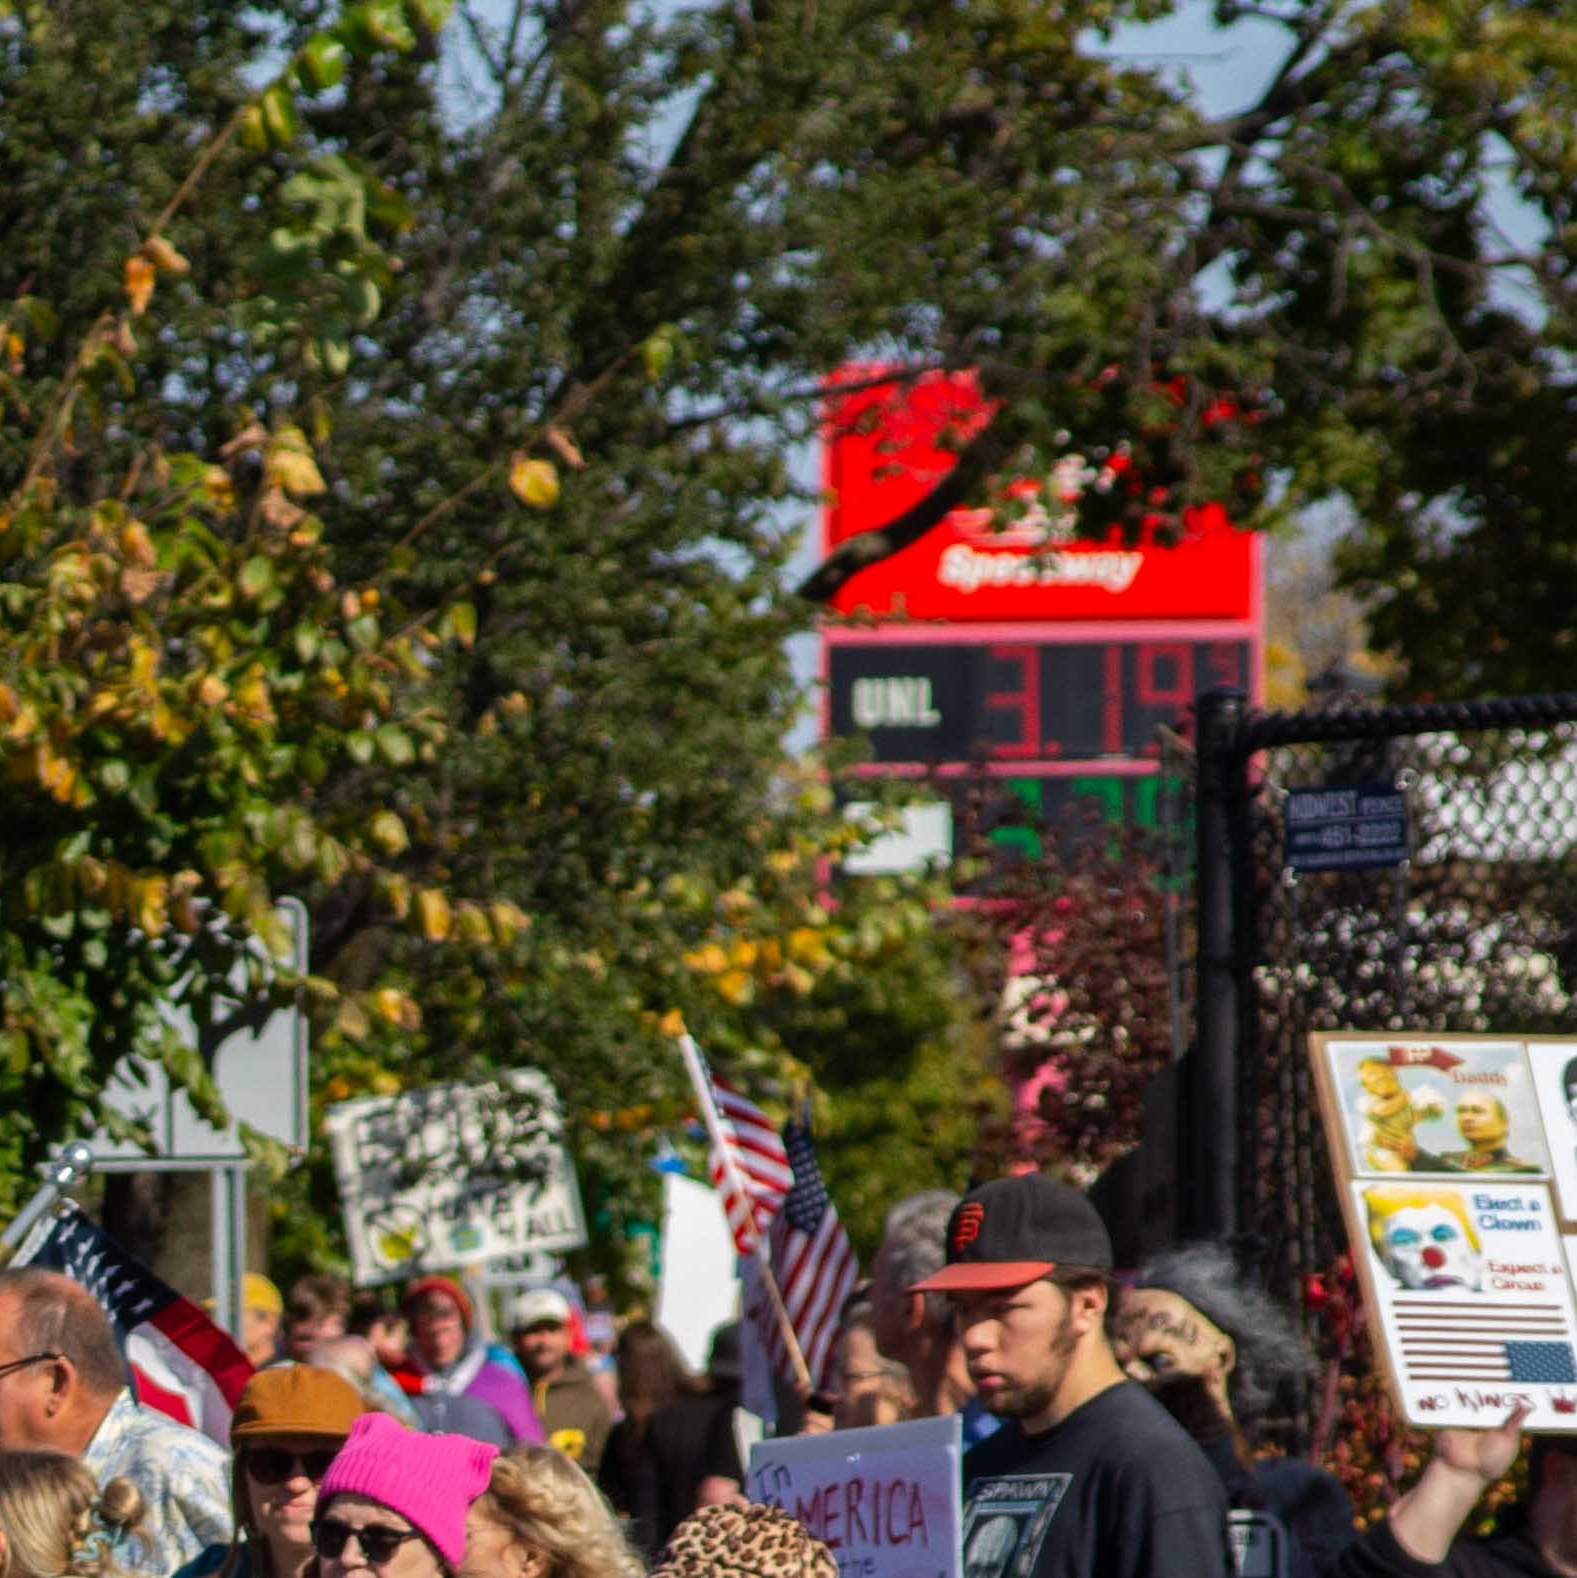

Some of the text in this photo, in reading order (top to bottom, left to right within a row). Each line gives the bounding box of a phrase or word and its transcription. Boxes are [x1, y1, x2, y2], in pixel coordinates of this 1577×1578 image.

[851, 677, 942, 728] UNL
[1473, 1194, 1524, 1211] Elect
[1477, 1214, 1542, 1231] Clown
[1486, 1258, 1550, 1276] Expect
[1491, 1276, 1546, 1291] Circus
[1418, 1393, 1450, 1411] NO
[755, 1461, 792, 1508] In
[770, 1478, 929, 1550] MERICA
